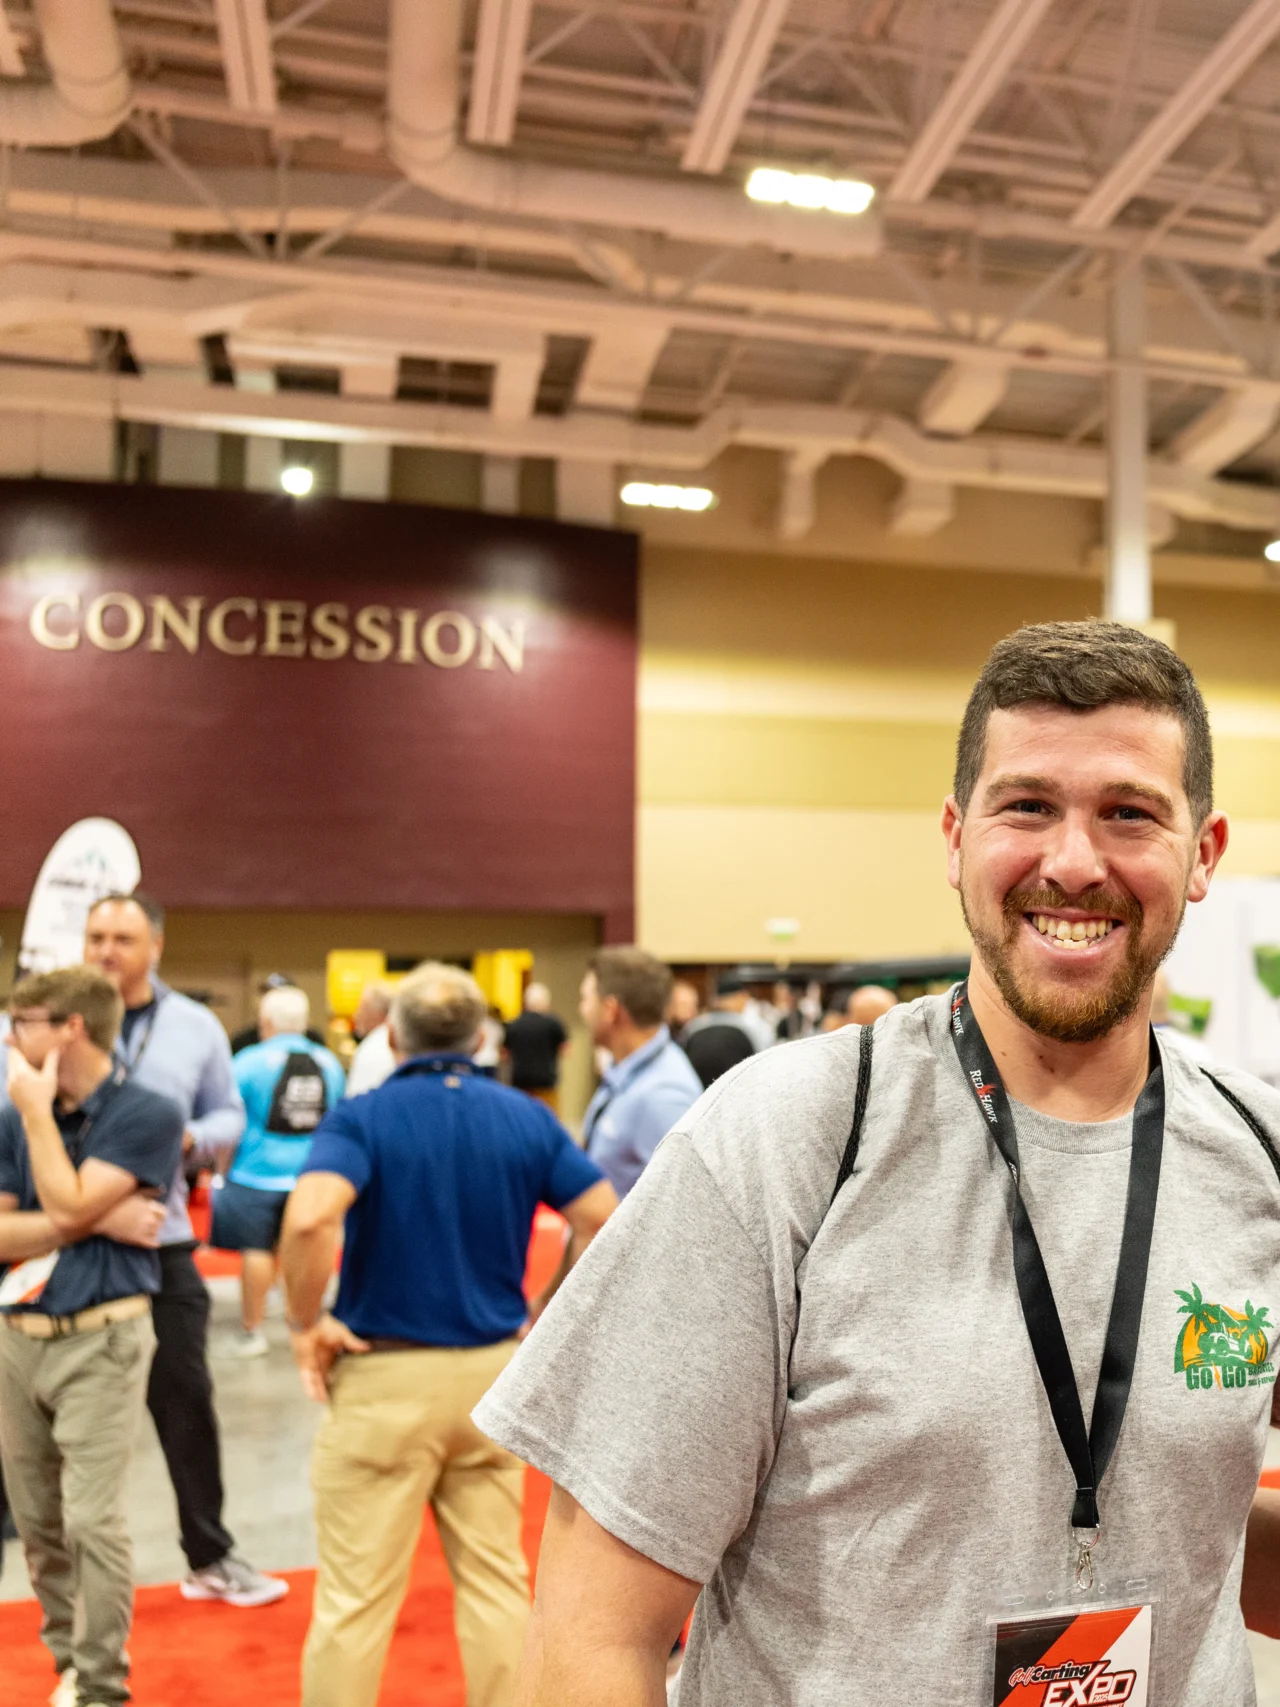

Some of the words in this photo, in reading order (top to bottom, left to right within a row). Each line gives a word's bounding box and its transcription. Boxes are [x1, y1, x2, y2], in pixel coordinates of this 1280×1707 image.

[29, 592, 525, 673] CONCESSION
[970, 1069, 985, 1090] RED
[979, 1094, 998, 1123] HAWK
[1186, 1363, 1213, 1390] GO
[1222, 1362, 1246, 1388] GO
[1043, 1663, 1136, 1707] EXPO
